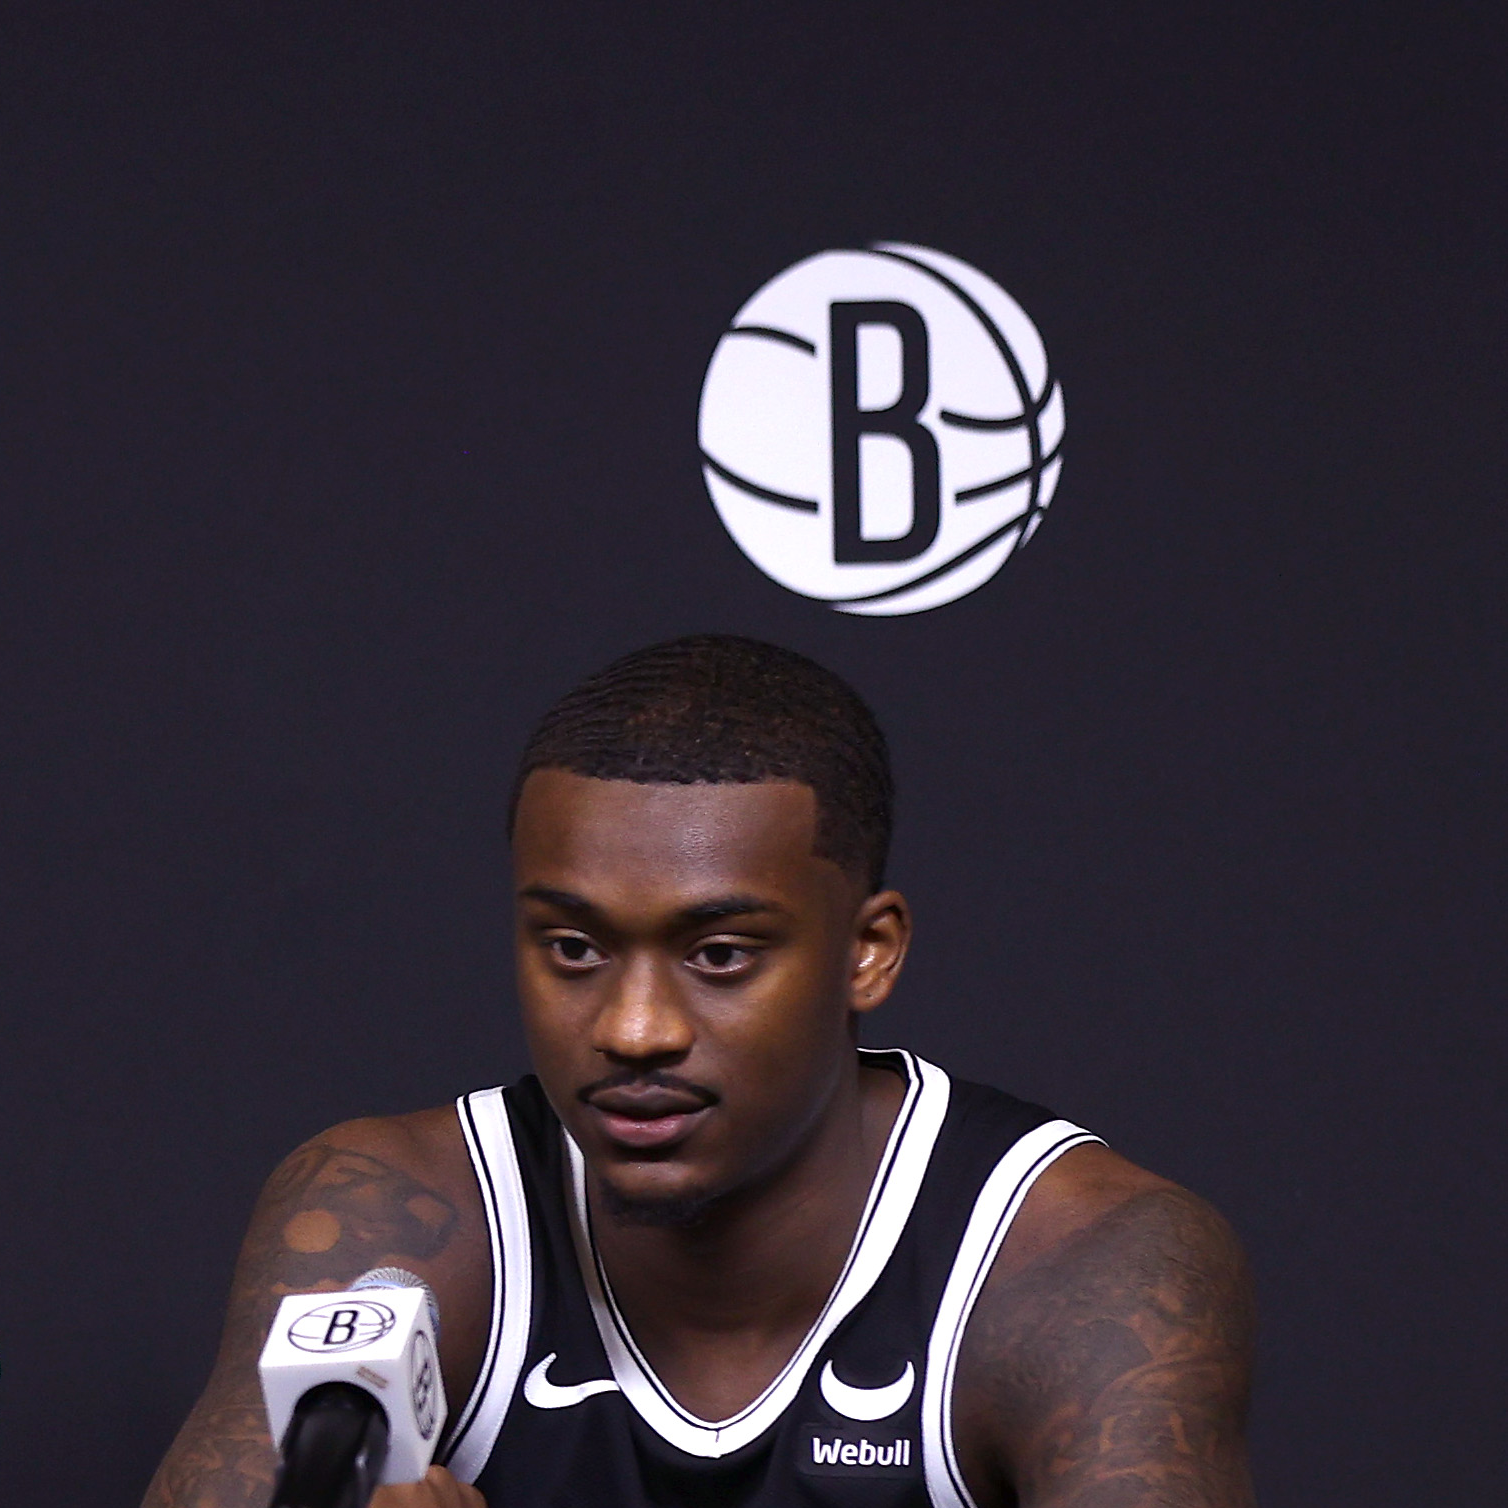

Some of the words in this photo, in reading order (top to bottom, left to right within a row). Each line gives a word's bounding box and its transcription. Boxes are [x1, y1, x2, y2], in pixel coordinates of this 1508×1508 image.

[829, 300, 942, 564] B
[323, 1309, 360, 1346] B
[812, 1436, 911, 1468] Webull
